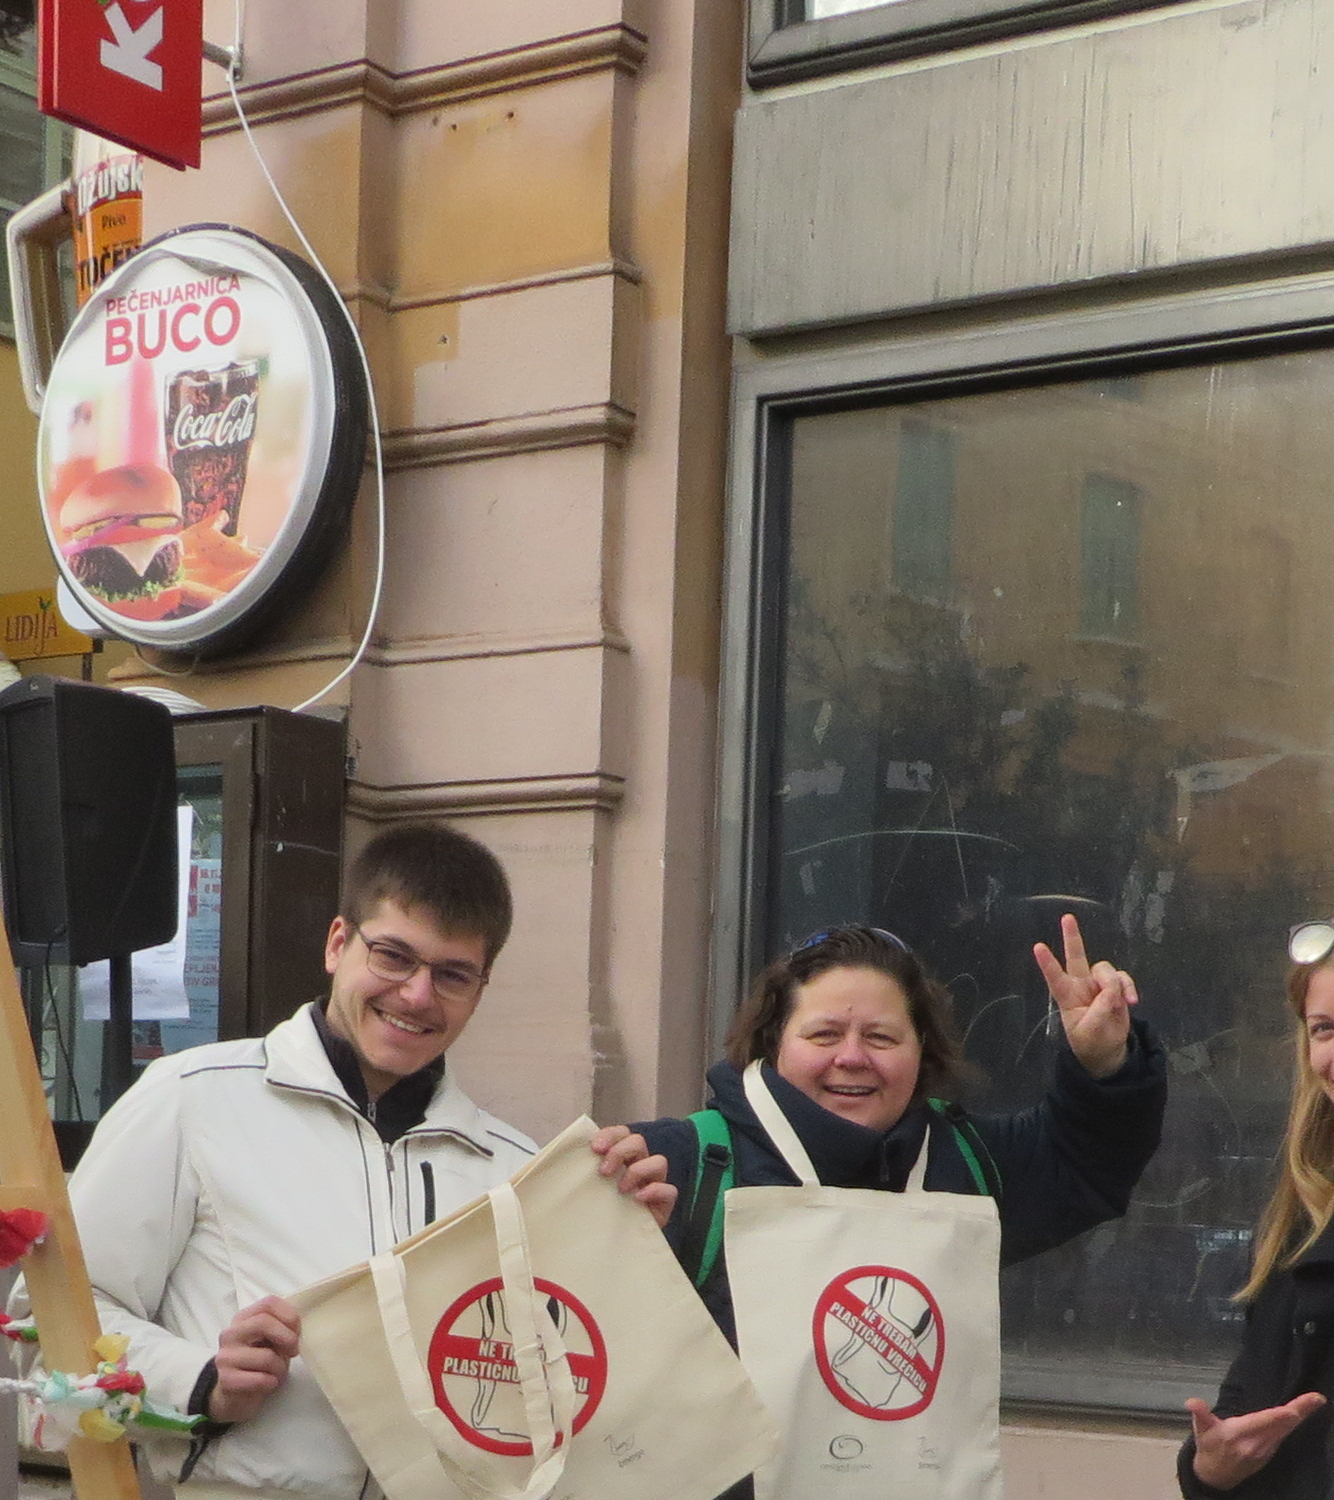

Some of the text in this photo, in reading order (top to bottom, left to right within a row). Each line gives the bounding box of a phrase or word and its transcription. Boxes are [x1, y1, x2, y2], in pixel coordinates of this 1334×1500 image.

[100, 0, 164, 93] K
[106, 274, 242, 318] PEČENJARNICA
[105, 296, 241, 367] BUCO
[478, 1339, 497, 1357] NE
[861, 1307, 918, 1360] NE TREBAM
